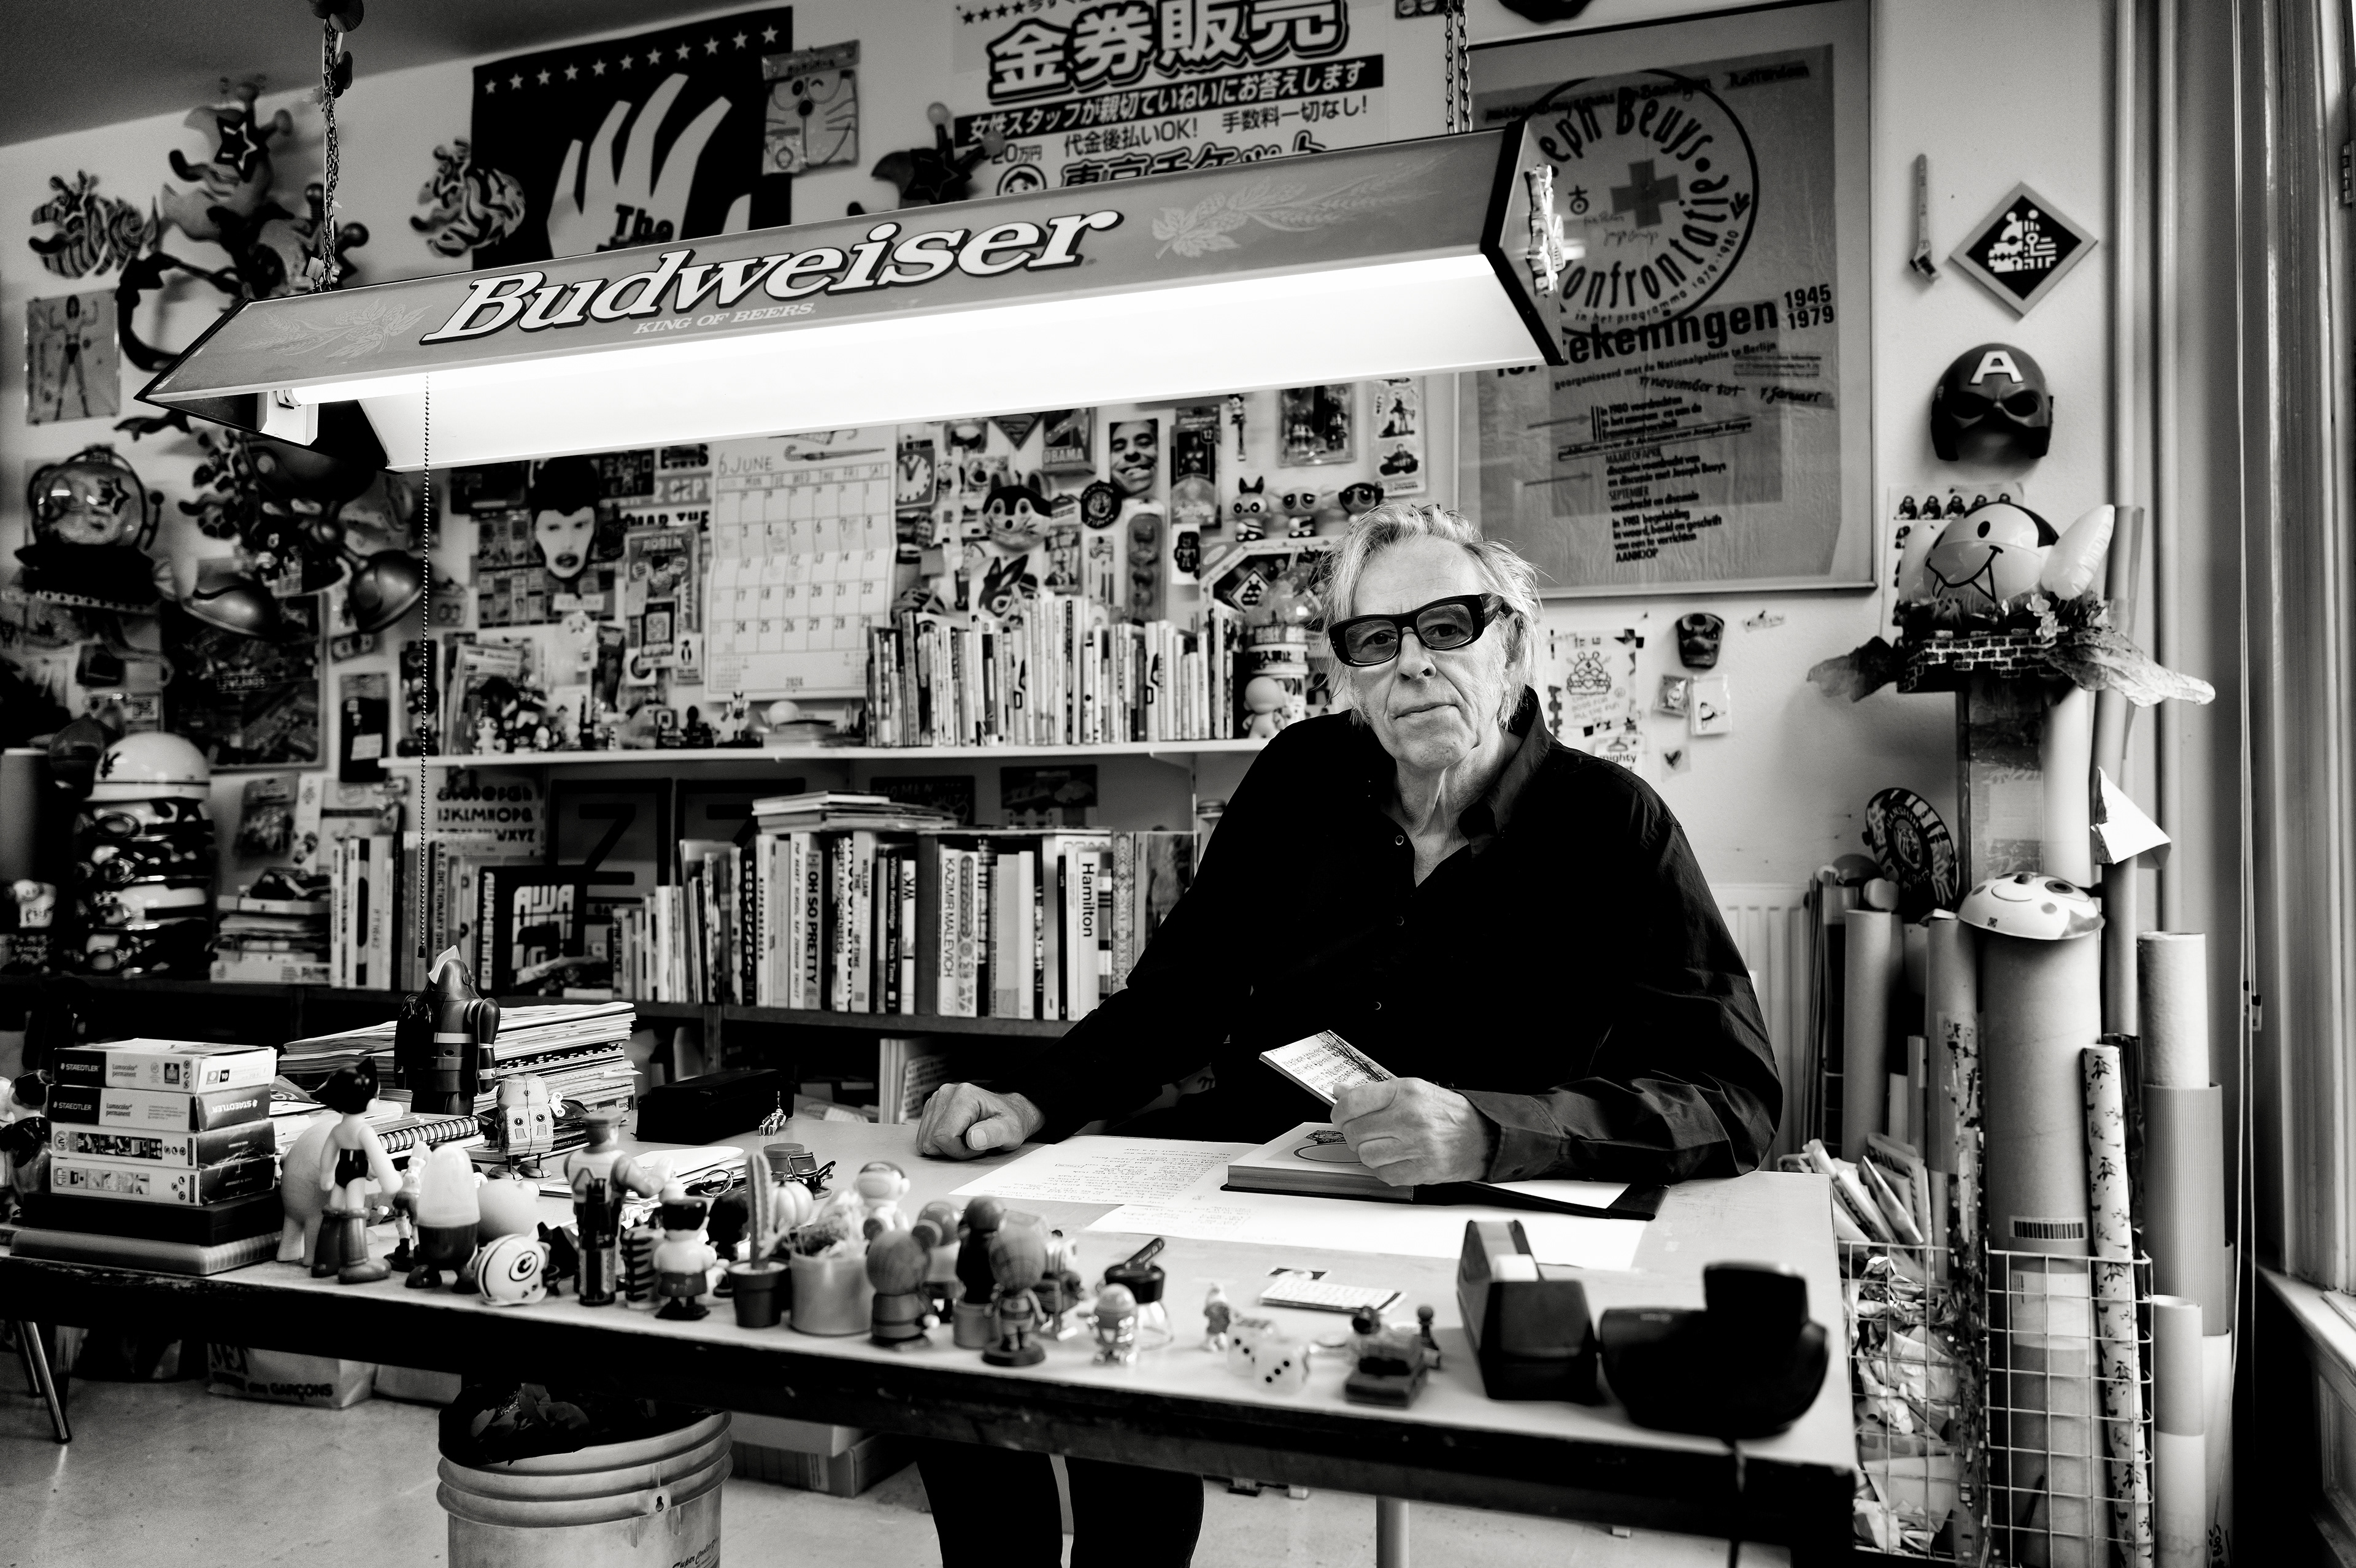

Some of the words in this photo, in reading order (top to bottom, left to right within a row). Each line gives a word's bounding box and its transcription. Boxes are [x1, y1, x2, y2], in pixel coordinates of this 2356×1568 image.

[989, 0, 1347, 102] 金券販売
[614, 204, 674, 239] The
[420, 206, 1124, 348] Budweiser
[1783, 283, 1832, 309] 1945
[633, 315, 693, 336] KING
[695, 311, 729, 330] OF
[731, 303, 812, 326] BEERS
[1787, 308, 1834, 330] 1979
[1562, 300, 1779, 366] ekeningen
[1968, 350, 2025, 386] A
[718, 453, 728, 475] 6
[730, 455, 773, 475] JUNE
[807, 871, 819, 893] OH
[807, 897, 818, 918] SO
[1082, 862, 1096, 937] Hamilton
[806, 922, 818, 985] PRETTY
[944, 913, 955, 978] MALEVICH
[65, 1063, 99, 1072] STAEDTLER
[58, 1102, 92, 1111] STAEDTLER
[211, 1100, 252, 1113] STAEDTLER
[554, 1140, 572, 1148] STAEDTLER
[270, 1382, 334, 1401] GARÇONS
